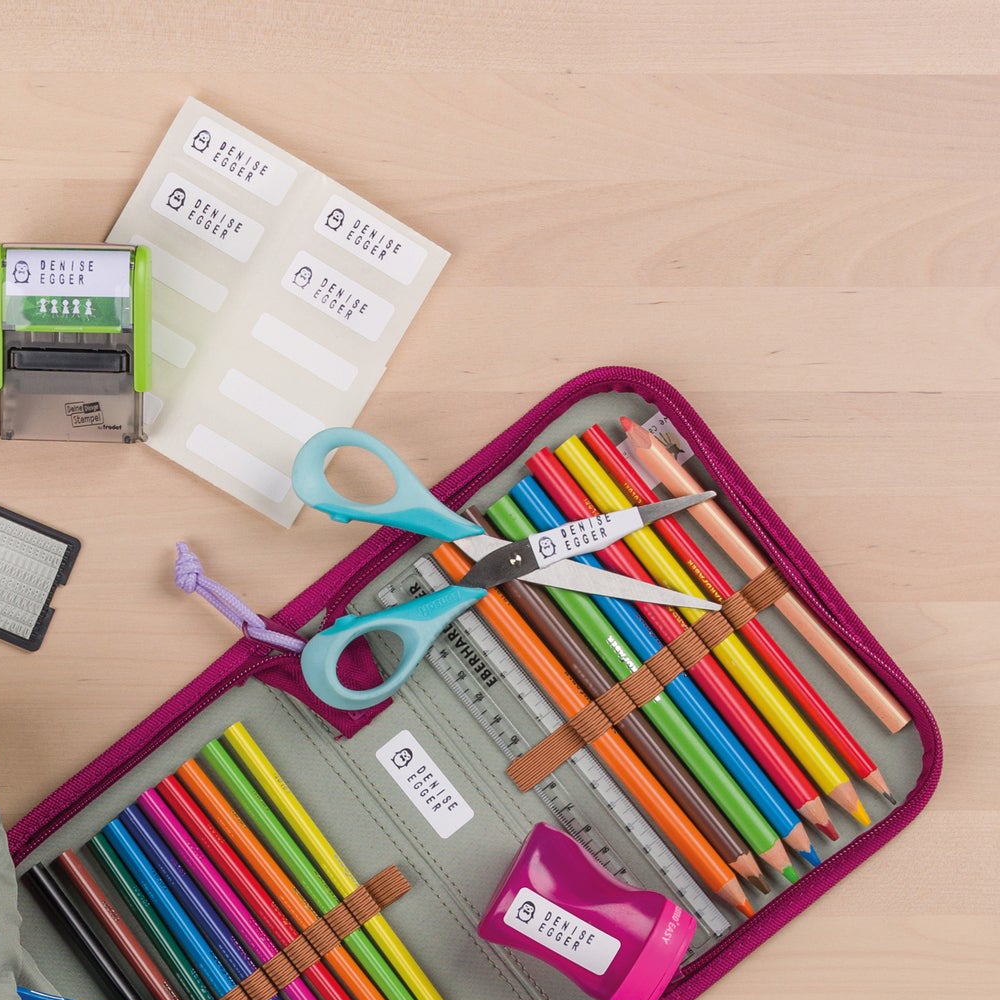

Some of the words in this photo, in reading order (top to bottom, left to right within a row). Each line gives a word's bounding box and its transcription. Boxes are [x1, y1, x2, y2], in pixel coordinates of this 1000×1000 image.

[212, 152, 253, 182] EGGER
[219, 141, 269, 176] DENISE
[187, 210, 228, 240] EGGER
[194, 198, 243, 233] DENISE
[346, 230, 387, 260] EGGER
[353, 219, 402, 254] DENISE
[40, 260, 94, 272] DENISE
[40, 273, 84, 285] EGGER
[313, 289, 353, 320] EGGER
[320, 278, 368, 314] DENISE
[560, 514, 612, 538] DENISE
[565, 528, 608, 551] EGGER
[407, 774, 442, 812] EGGER
[417, 765, 458, 811] DENISE
[538, 922, 580, 951] EGGER
[544, 911, 595, 945] DENISE
[662, 922, 677, 945] EASY
